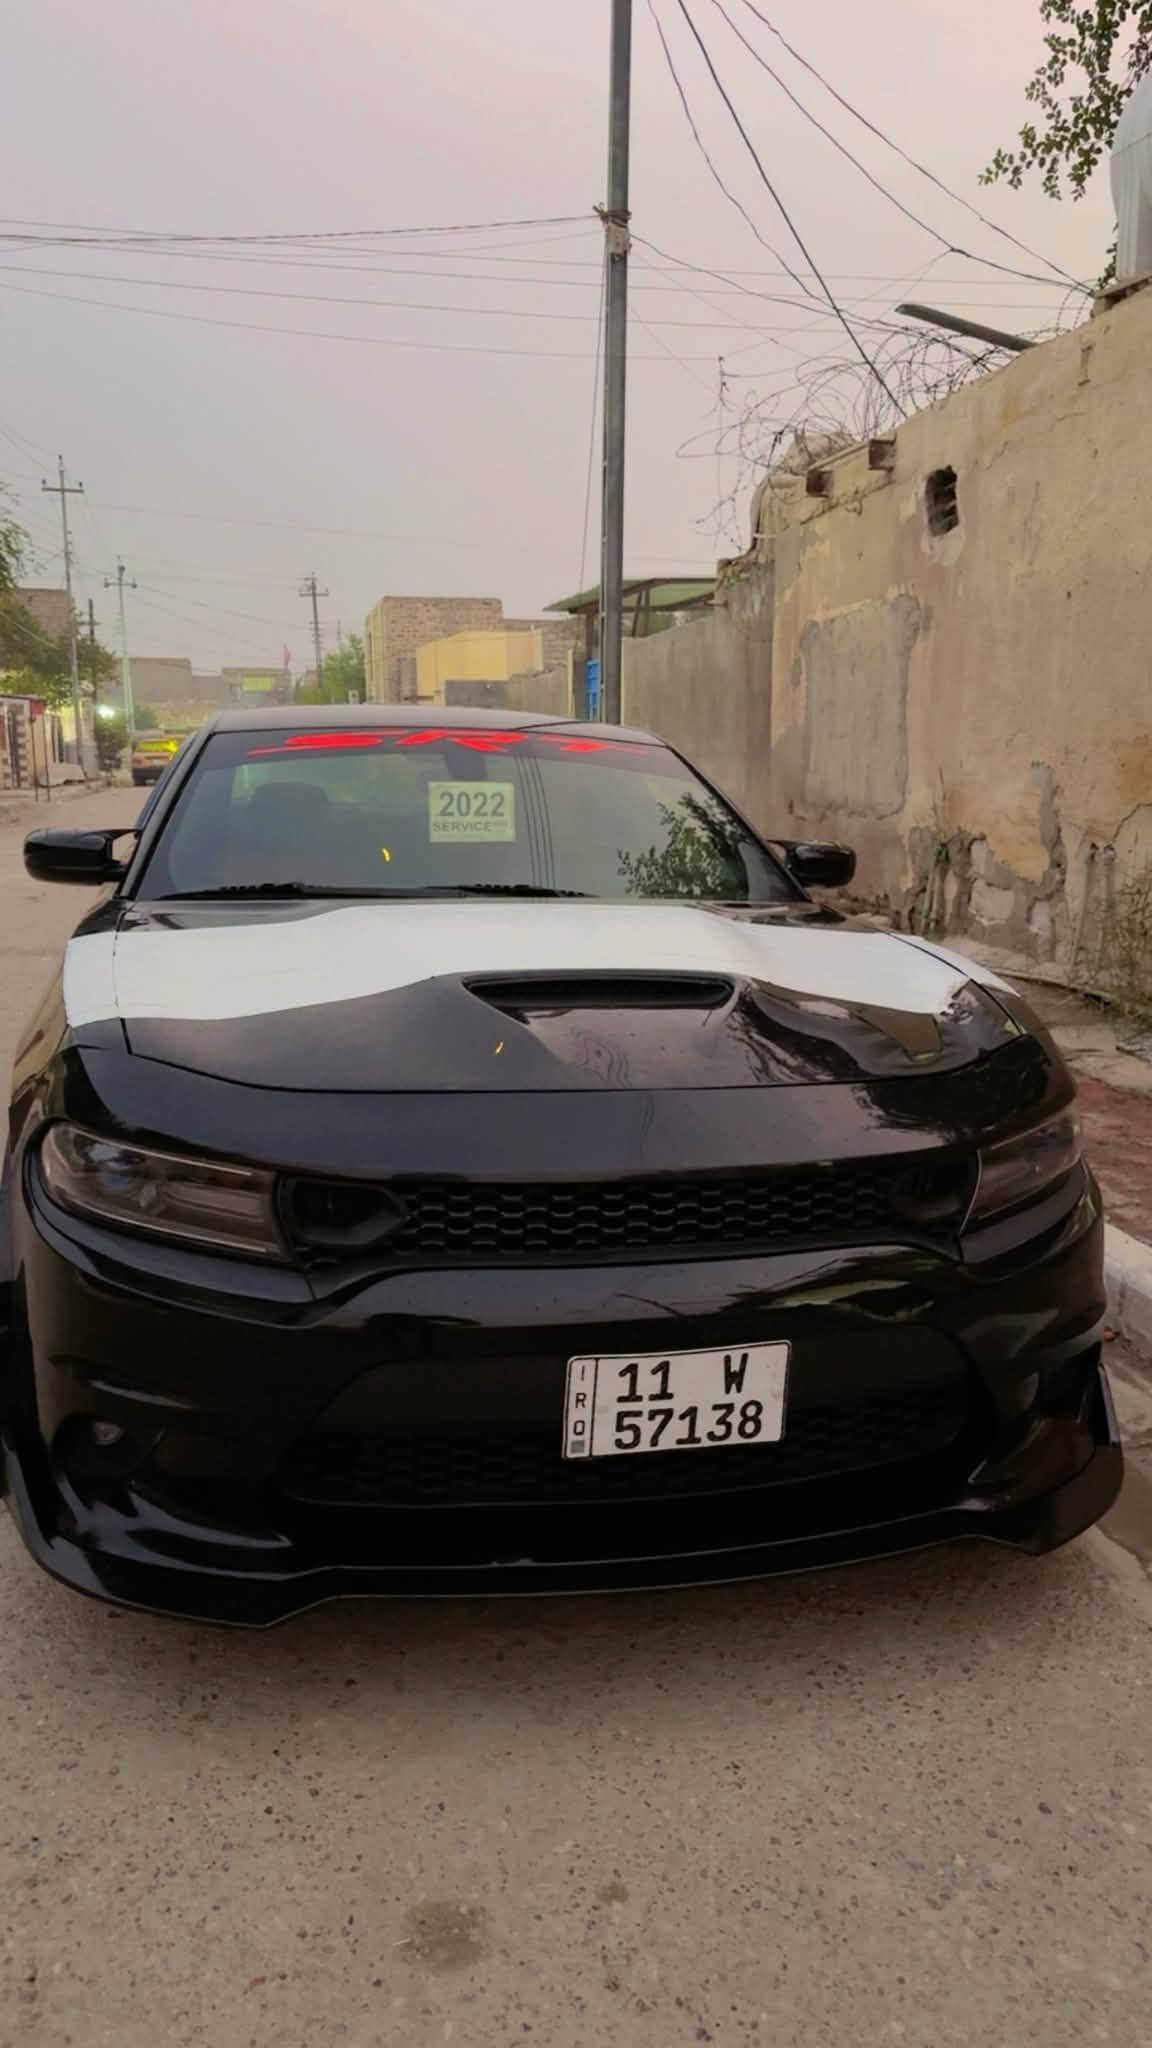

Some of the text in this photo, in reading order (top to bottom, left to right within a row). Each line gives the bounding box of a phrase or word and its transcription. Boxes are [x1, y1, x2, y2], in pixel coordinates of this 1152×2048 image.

[439, 791, 506, 817] 2022
[432, 821, 493, 833] SERVICE
[616, 1353, 749, 1403] 11 W
[614, 1400, 764, 1450] 57138
